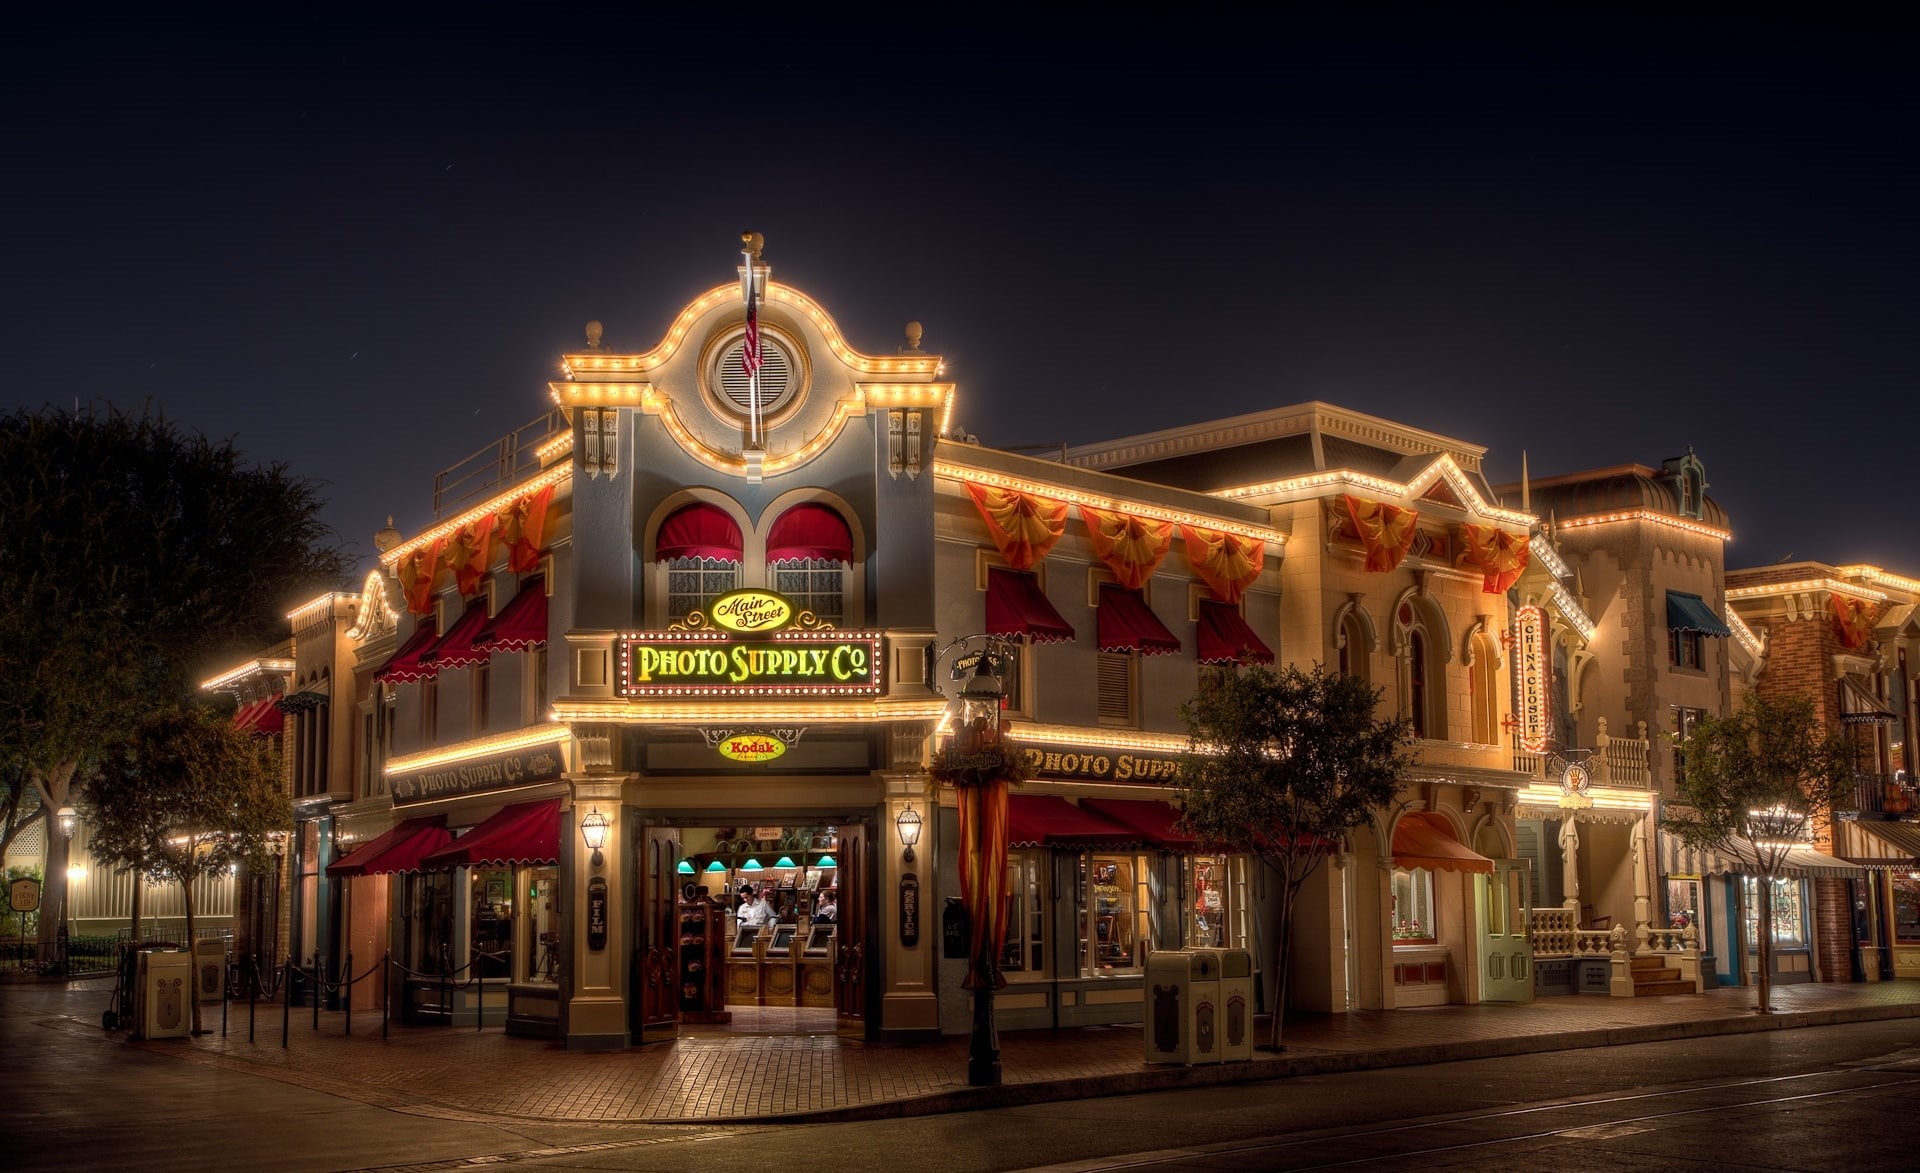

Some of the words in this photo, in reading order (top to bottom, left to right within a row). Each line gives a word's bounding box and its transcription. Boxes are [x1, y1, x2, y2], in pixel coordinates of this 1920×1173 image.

[718, 597, 775, 616] Main
[736, 608, 784, 628] Street
[638, 647, 728, 681] PHOTO
[729, 646, 829, 682] SUPPLY
[1525, 625, 1536, 672] CHINA
[1527, 676, 1538, 733] CLOSET
[731, 742, 774, 753] Kodak
[419, 772, 458, 796] PHOTO
[459, 763, 502, 789] SUPPLY
[592, 900, 603, 933] FILM
[904, 889, 915, 936] SERVICE
